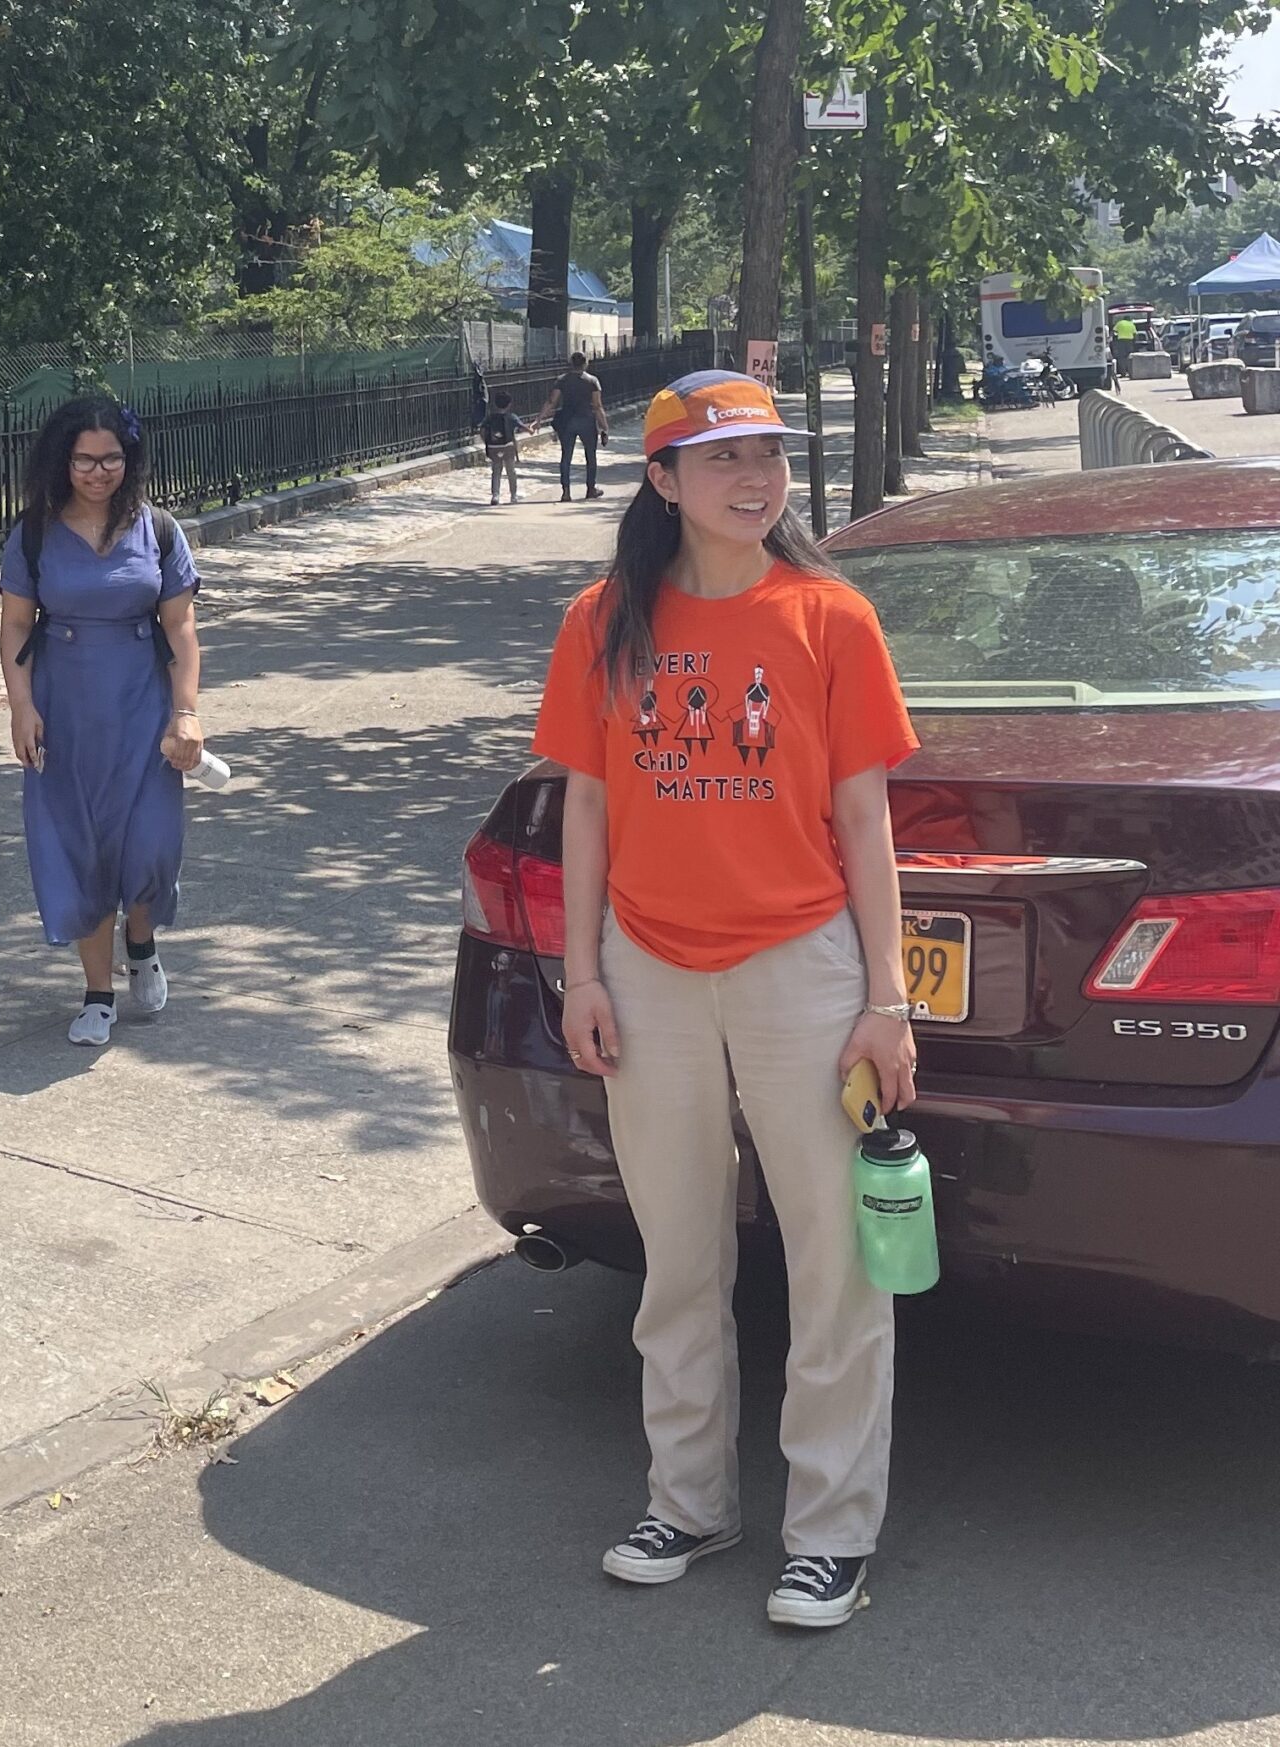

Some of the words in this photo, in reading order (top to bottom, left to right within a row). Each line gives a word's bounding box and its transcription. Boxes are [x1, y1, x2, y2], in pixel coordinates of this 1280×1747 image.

[656, 776, 775, 800] MATTERS
[902, 946, 947, 996] 99
[1113, 1019, 1162, 1036] ES
[1170, 1021, 1247, 1041] 350
